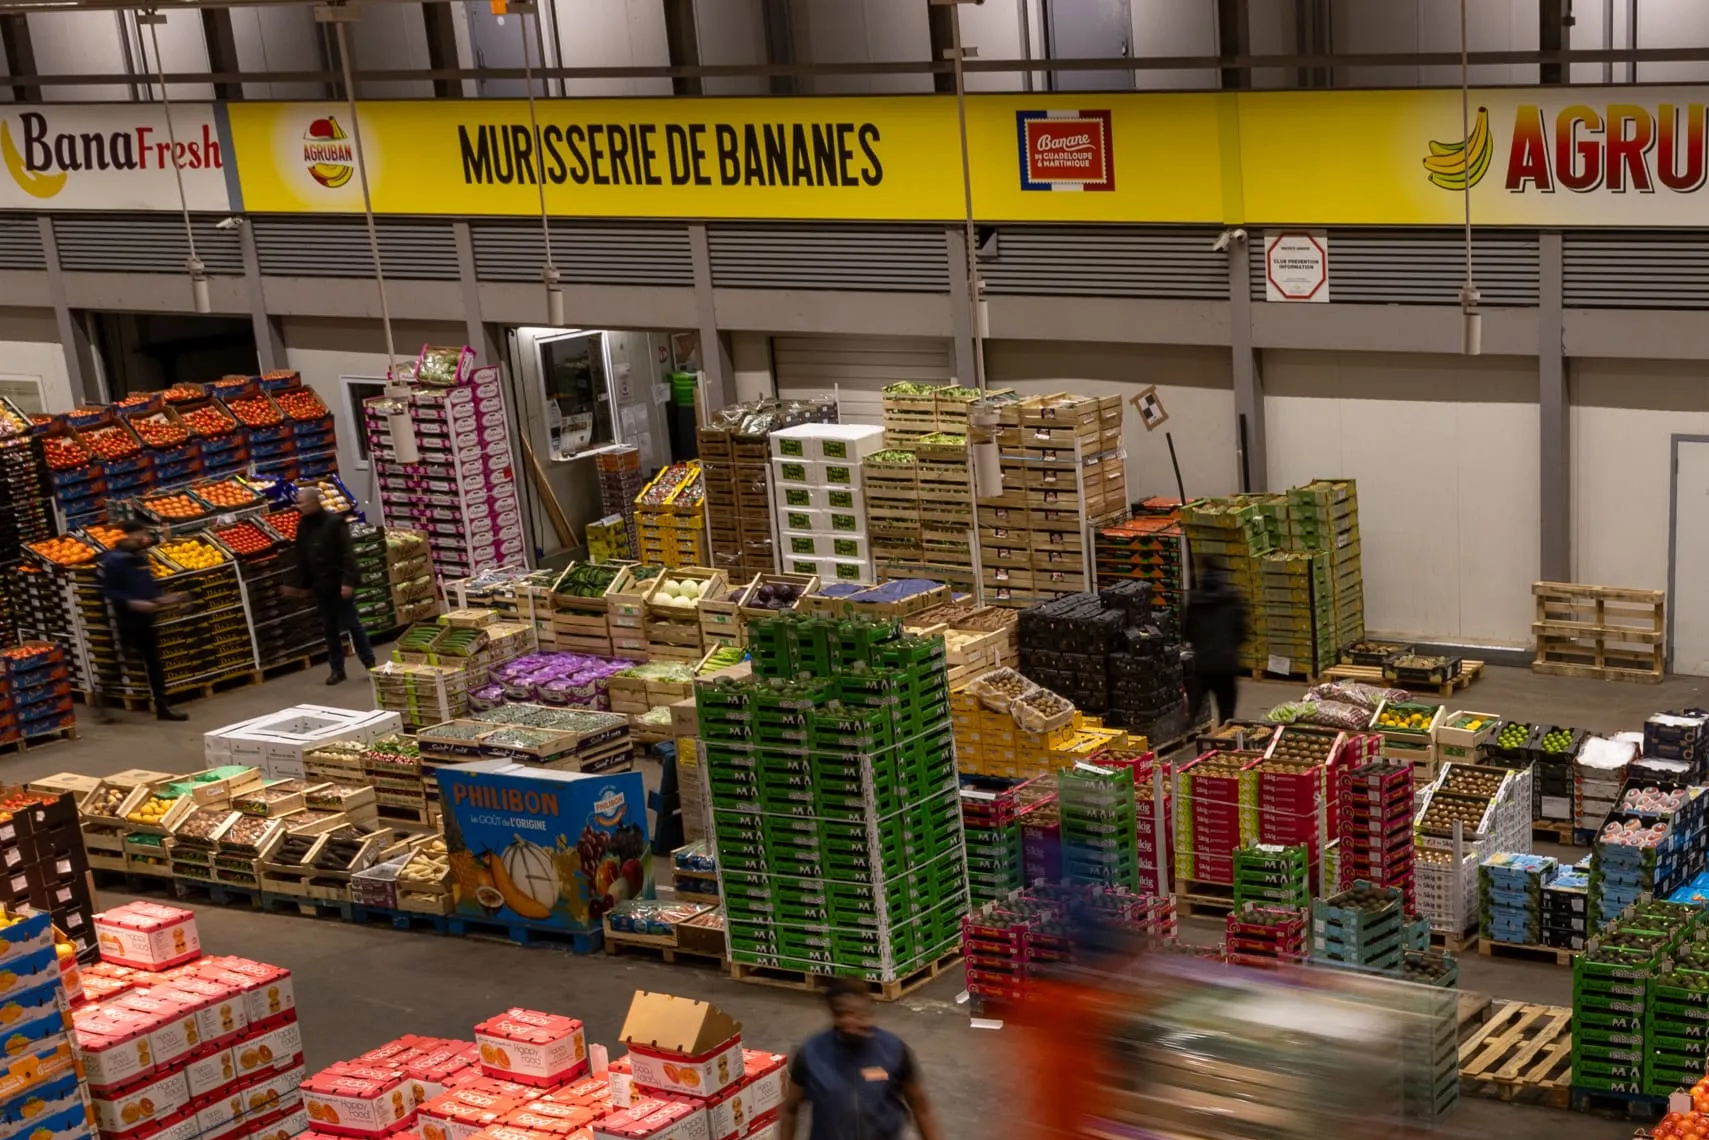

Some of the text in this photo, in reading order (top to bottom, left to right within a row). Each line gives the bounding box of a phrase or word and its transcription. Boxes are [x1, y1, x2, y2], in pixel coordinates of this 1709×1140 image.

[19, 112, 224, 171] BanaFresh
[1037, 134, 1096, 151] Banane
[304, 143, 352, 162] AGRUBAN
[458, 123, 884, 187] MURISSERIE DE BANANES
[1043, 152, 1092, 160] GUADELOUPE
[453, 783, 559, 816] PHILIBON
[513, 1042, 542, 1060] Happy
[520, 1053, 542, 1066] Food
[340, 1100, 368, 1115] Happy
[348, 1109, 371, 1120] Food
